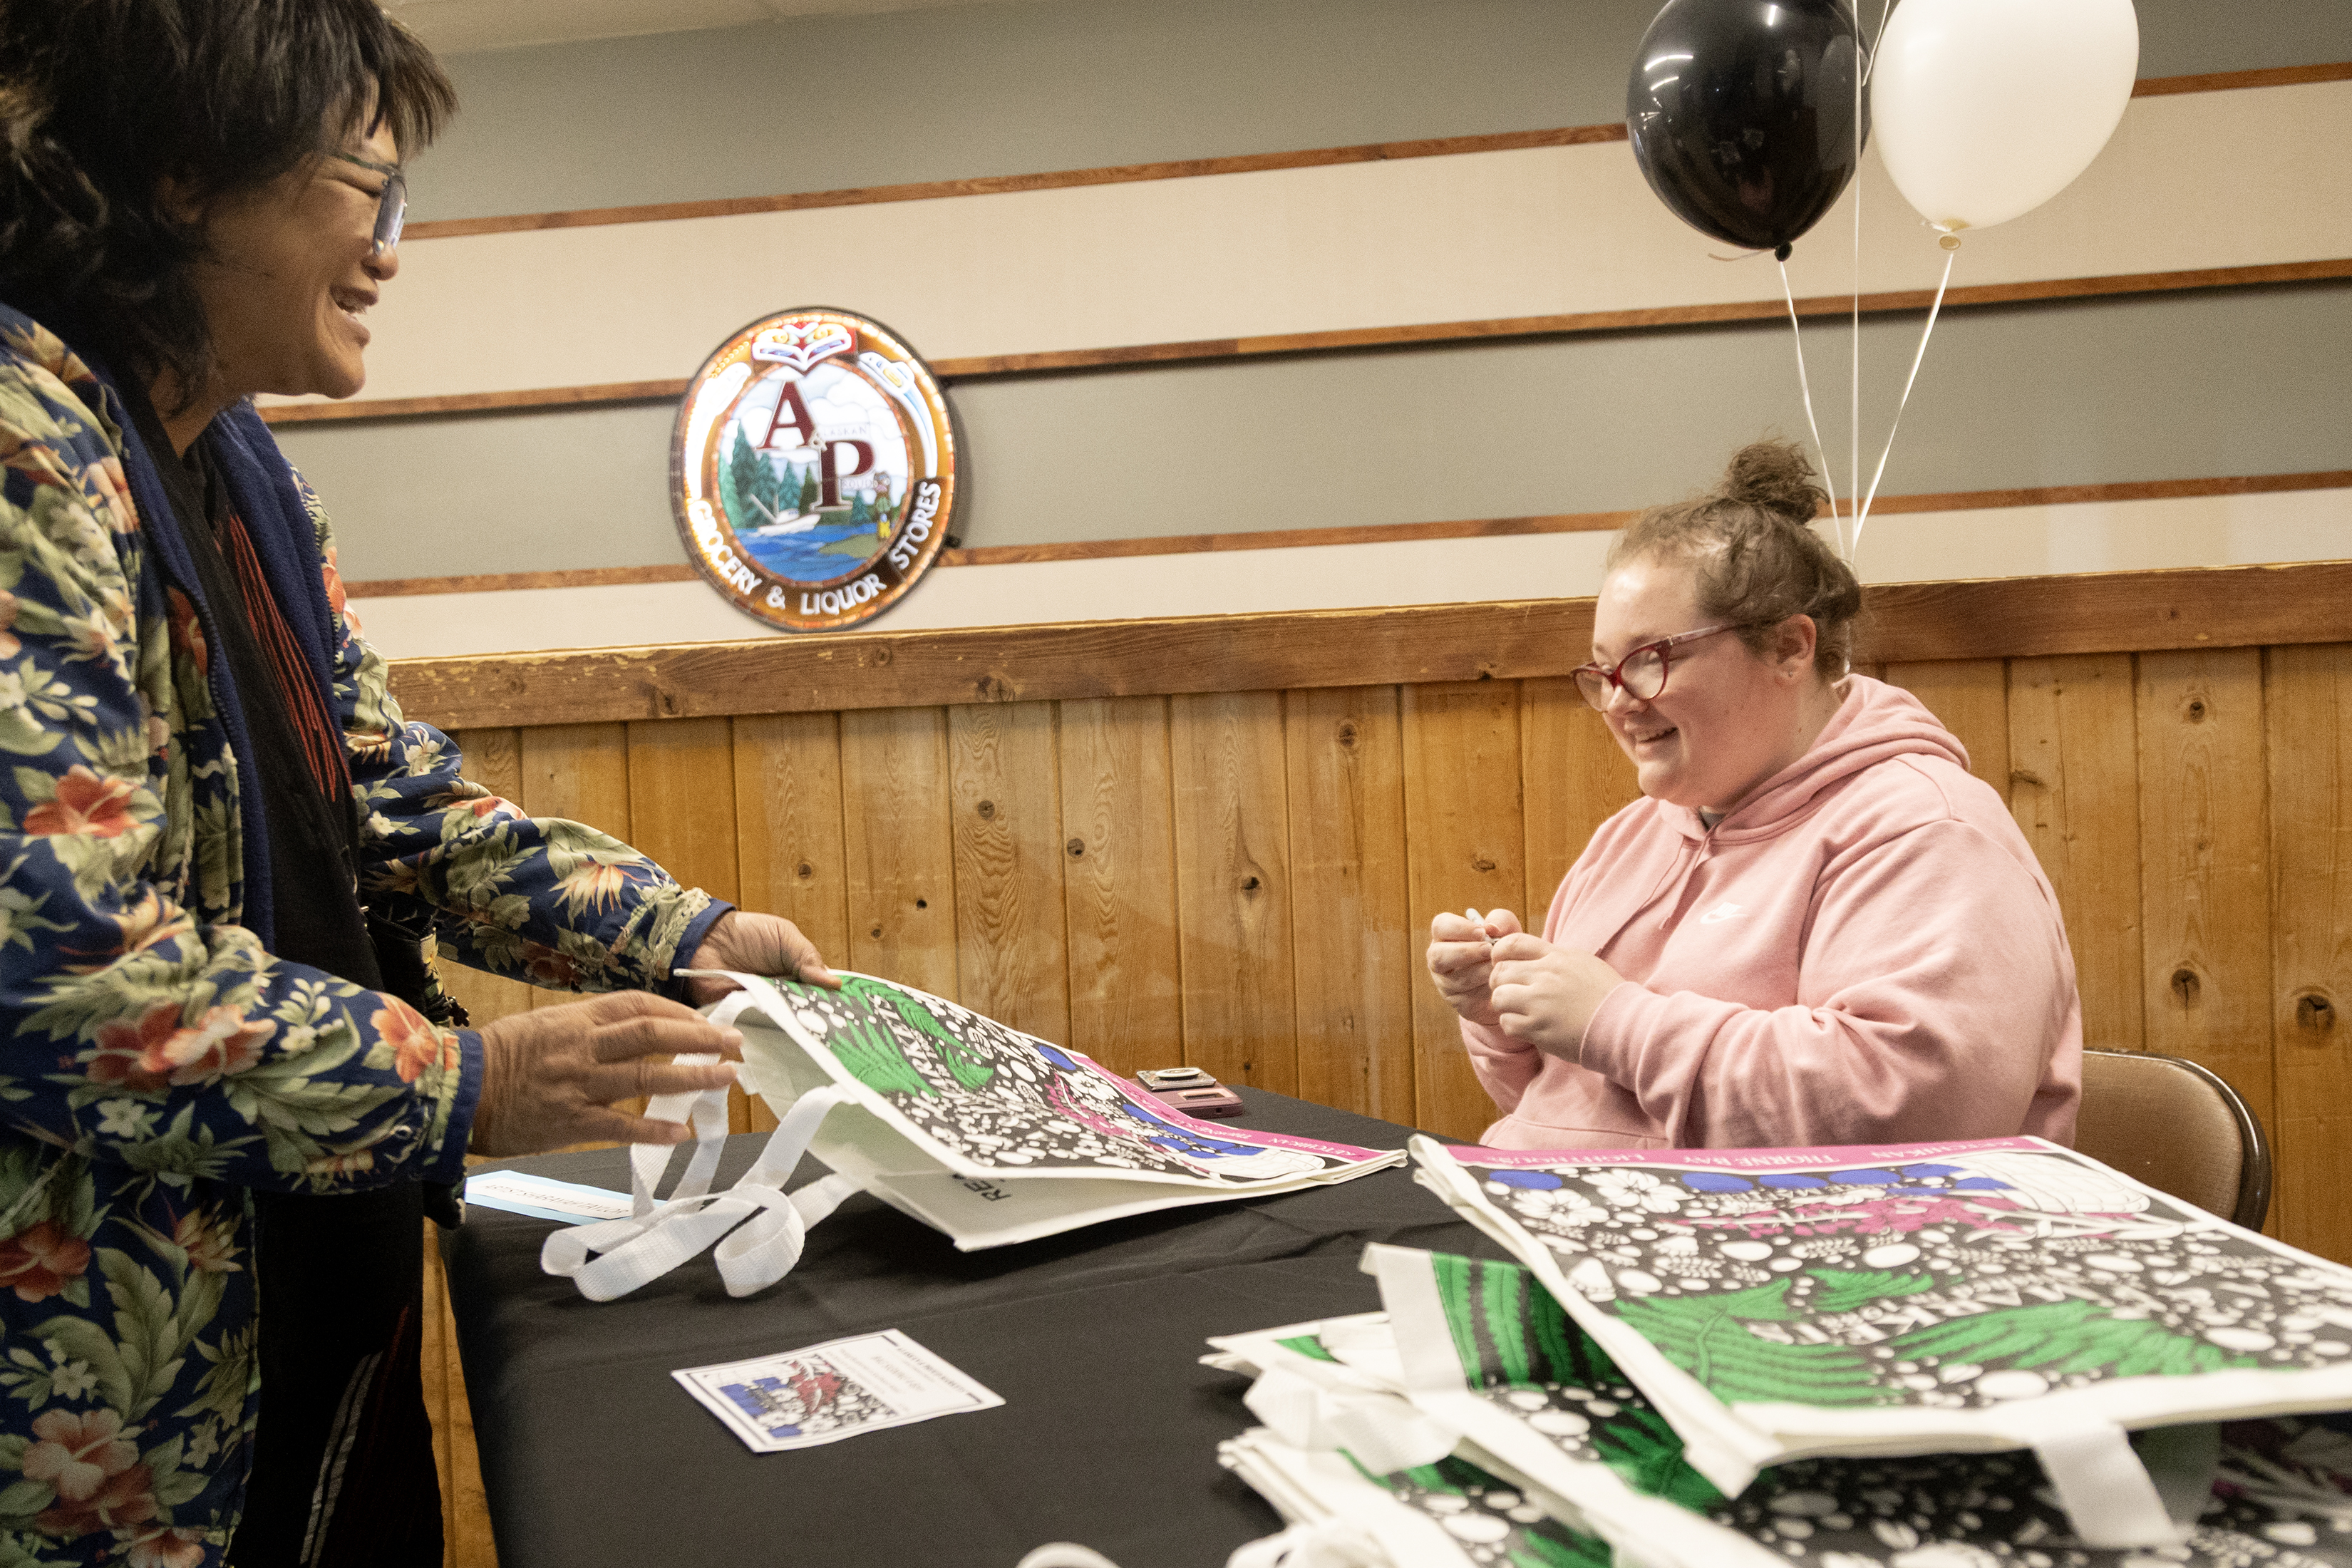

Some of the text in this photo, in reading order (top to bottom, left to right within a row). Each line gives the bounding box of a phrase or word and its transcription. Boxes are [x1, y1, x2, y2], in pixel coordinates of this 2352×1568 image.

[822, 425, 867, 437] LASKAN
[754, 380, 818, 450] A
[809, 439, 875, 512] P
[841, 477, 873, 489] ROUD
[766, 585, 786, 609] &
[800, 573, 887, 615] LIQUOR
[889, 482, 941, 569] STORES
[1684, 1154, 1840, 1167] THORNE BAY
